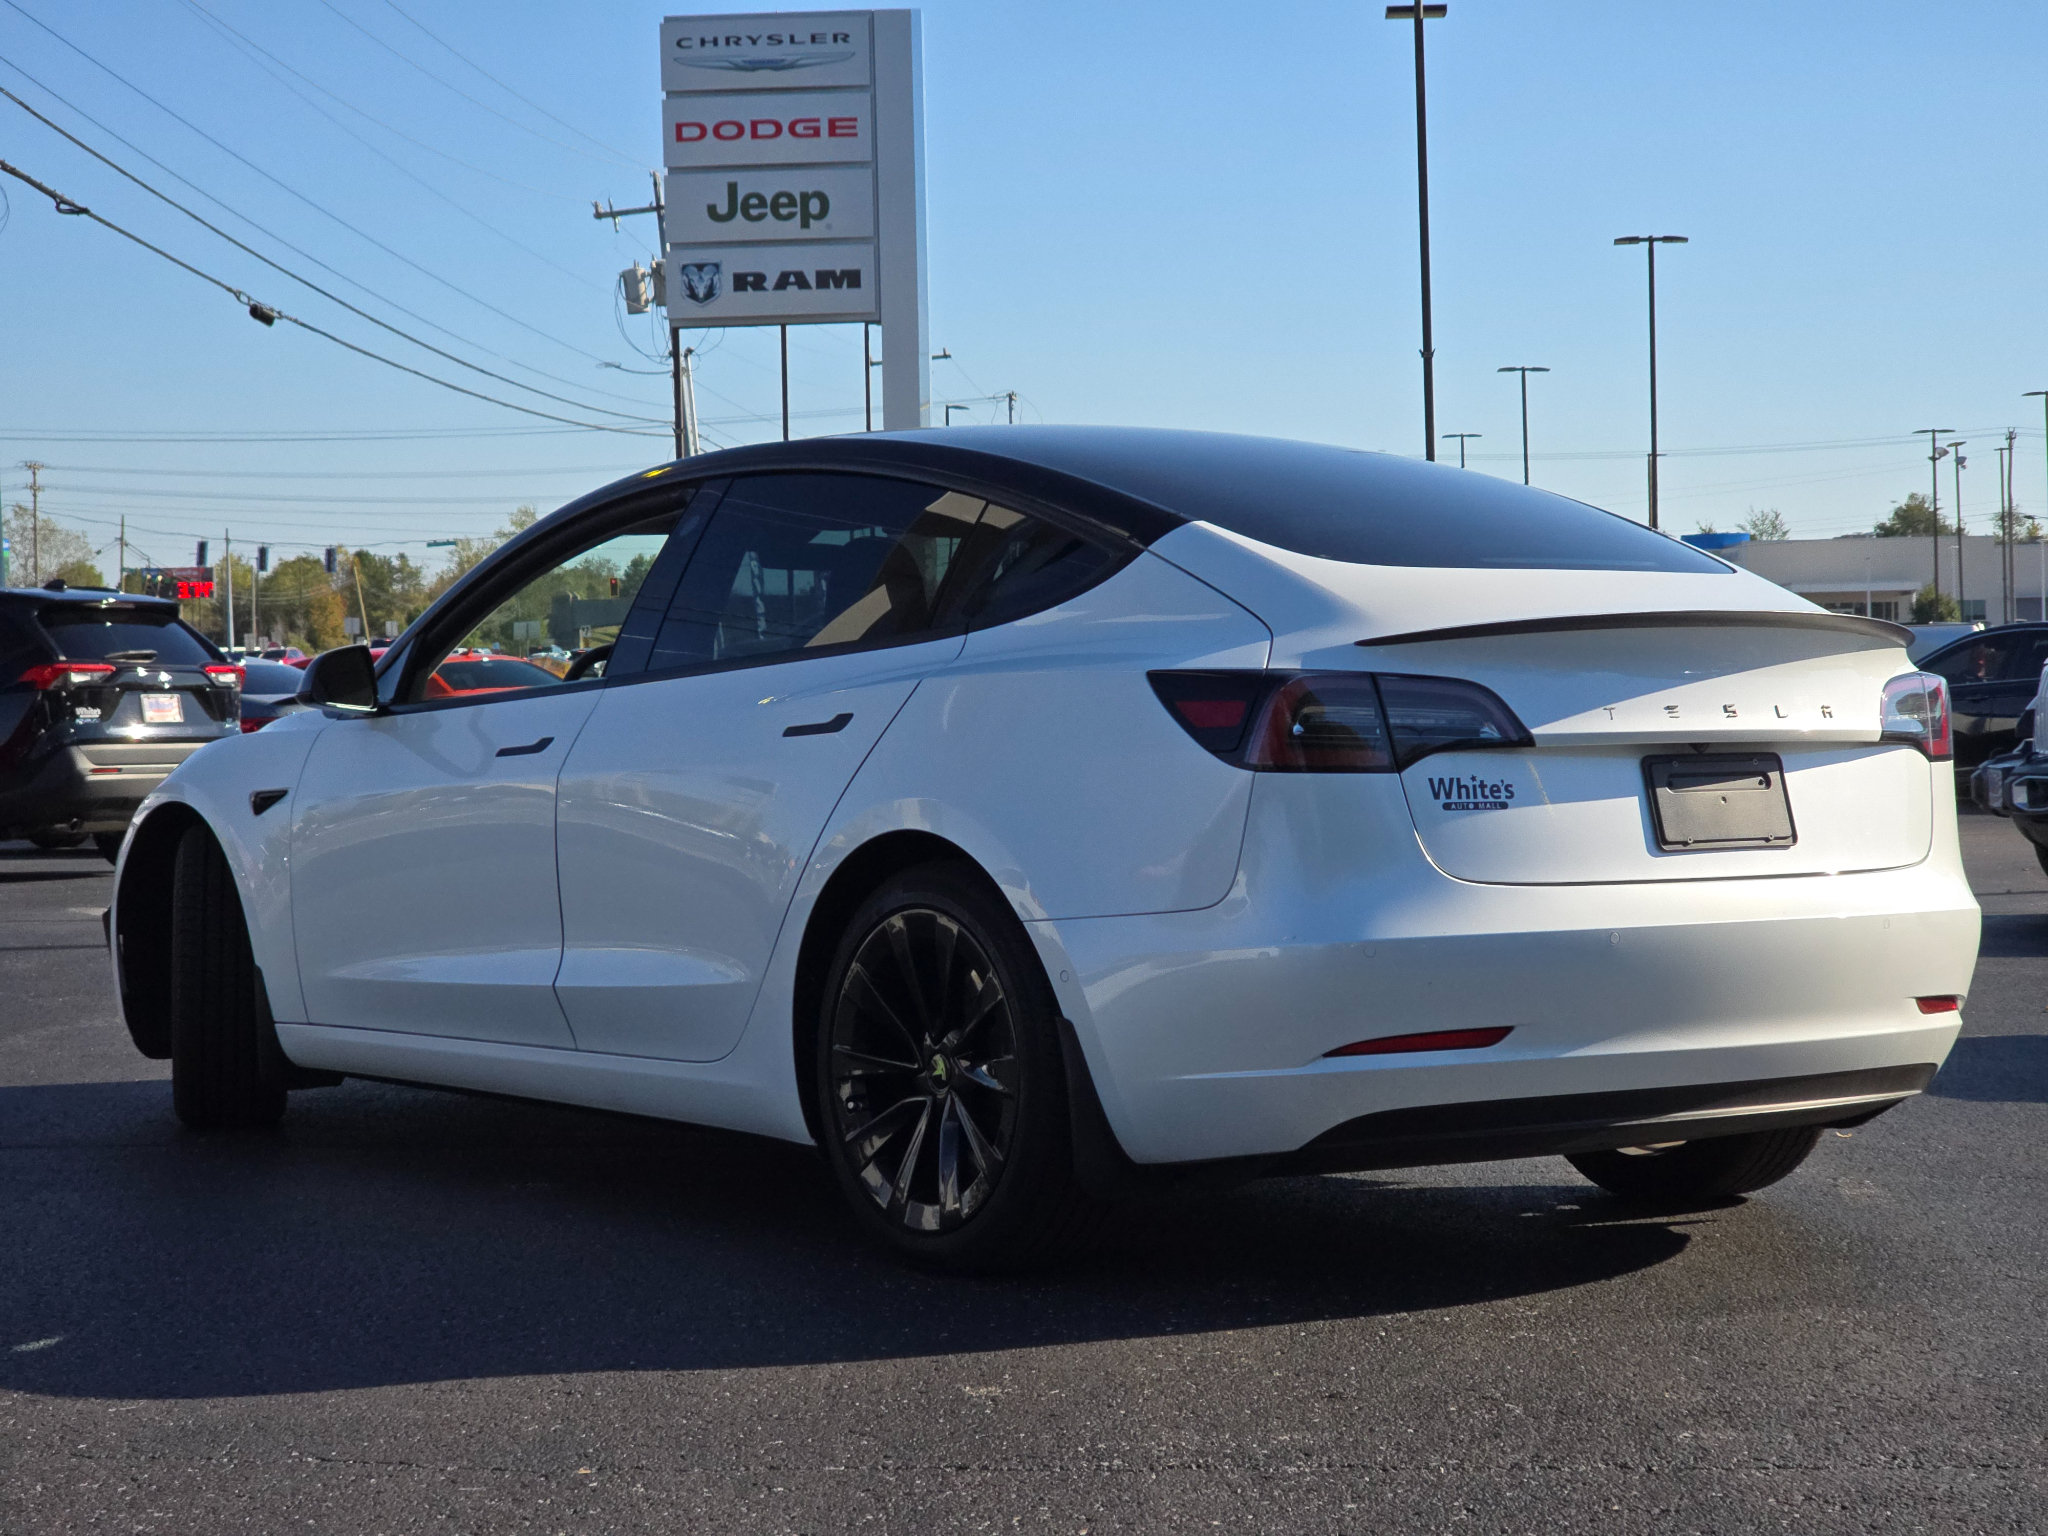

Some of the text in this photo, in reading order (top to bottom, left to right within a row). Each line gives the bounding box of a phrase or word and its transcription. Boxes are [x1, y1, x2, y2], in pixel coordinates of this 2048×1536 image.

[676, 32, 851, 49] CHRYSLER
[675, 117, 858, 142] DODGE
[707, 181, 830, 229] Jeep
[733, 269, 861, 292] RAM
[1602, 703, 1834, 721] TESLA
[1428, 774, 1515, 800] White's
[1450, 802, 1475, 810] AUTO
